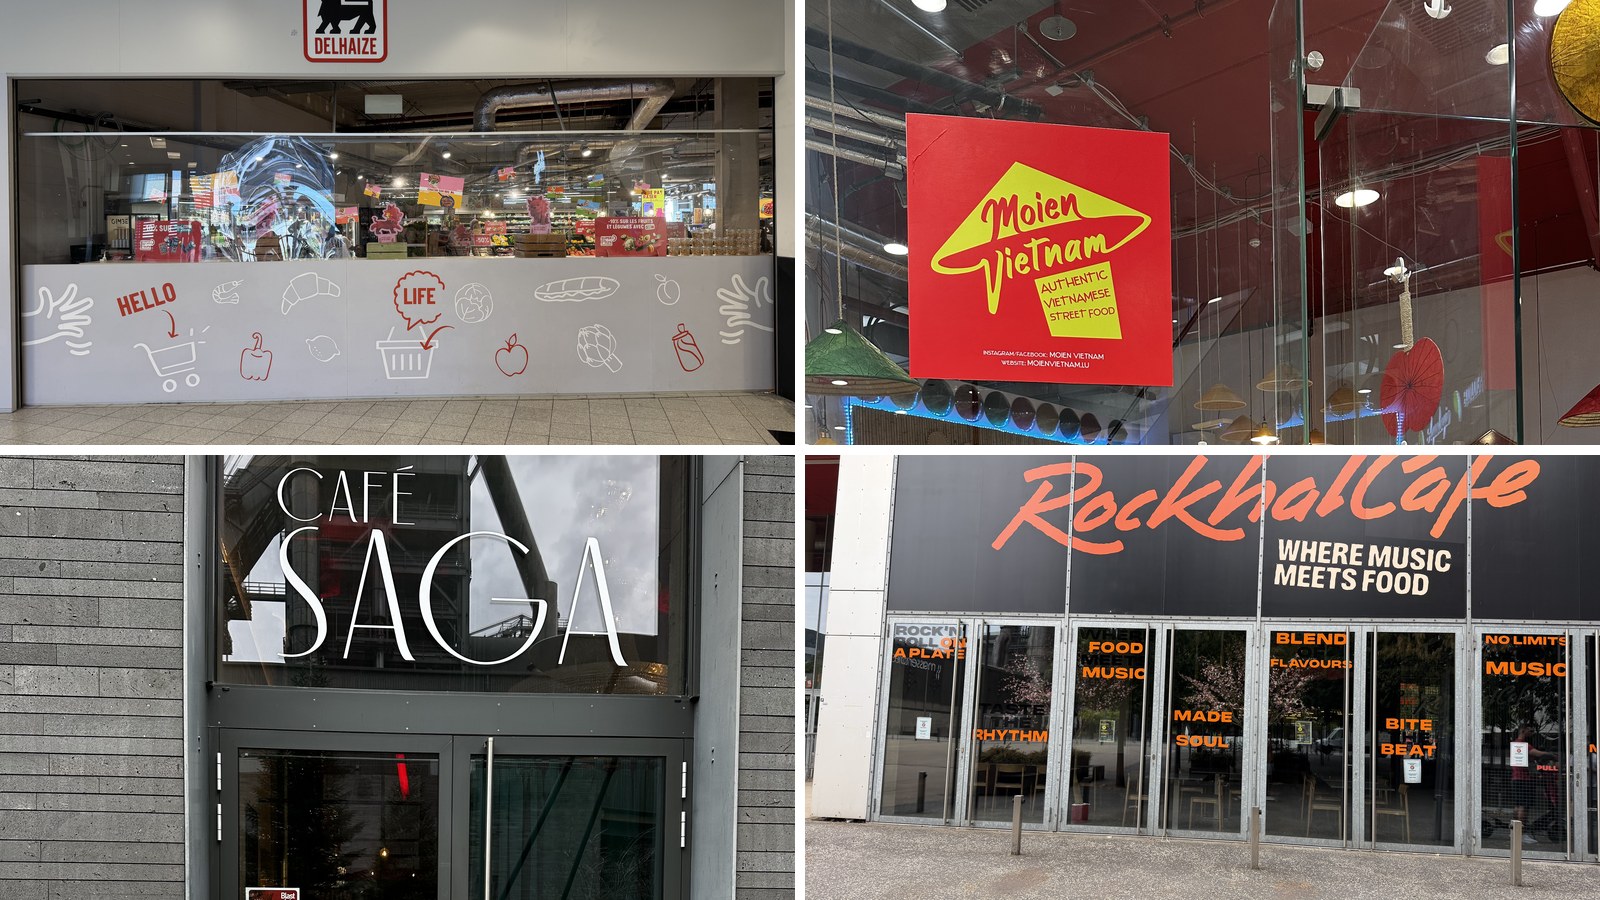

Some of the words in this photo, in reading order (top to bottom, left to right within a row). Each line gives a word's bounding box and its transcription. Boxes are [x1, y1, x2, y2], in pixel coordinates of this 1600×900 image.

[314, 37, 378, 55] DELHAIZE
[981, 192, 1083, 241] Moien
[982, 233, 1108, 315] Vietnam
[1041, 270, 1108, 294] AUTHENTIC
[116, 281, 177, 317] HELLO
[403, 287, 436, 305] LIFE
[1043, 288, 1110, 308] VIETNAMESE
[1049, 309, 1086, 321] STREET
[1088, 306, 1115, 318] FOOD
[983, 349, 1048, 358] INSTAGRAM/FACEBOOK:
[1049, 351, 1071, 359] MOIEN
[1074, 352, 1104, 360] VIETNAM
[1027, 360, 1090, 368] MOIENVIETNAM.LU
[277, 465, 416, 525] CAFÉ
[1278, 538, 1364, 567] WHERE
[1367, 543, 1452, 573] MUSIC
[1273, 563, 1357, 591] MEETS
[1362, 569, 1429, 596] FOOD
[277, 526, 629, 667] SAGA
[894, 636, 938, 648] ROLL
[940, 637, 967, 648] ON
[1275, 632, 1347, 646] BLEND
[1485, 635, 1510, 645] NO
[1513, 635, 1567, 646] LIMITS
[894, 647, 907, 659] A
[909, 648, 965, 660] PLATE
[1088, 641, 1144, 655] FOOD
[1270, 658, 1353, 669] FLAVOURS
[1485, 661, 1567, 677] MUSIC
[1082, 666, 1145, 680] MUSIC
[1174, 710, 1233, 723] MADE
[1385, 718, 1432, 731] BITE
[972, 728, 1048, 743] RHYTHM
[1175, 734, 1229, 748] SOUL
[1380, 743, 1437, 757] BEAT
[280, 892, 296, 900] Blast
